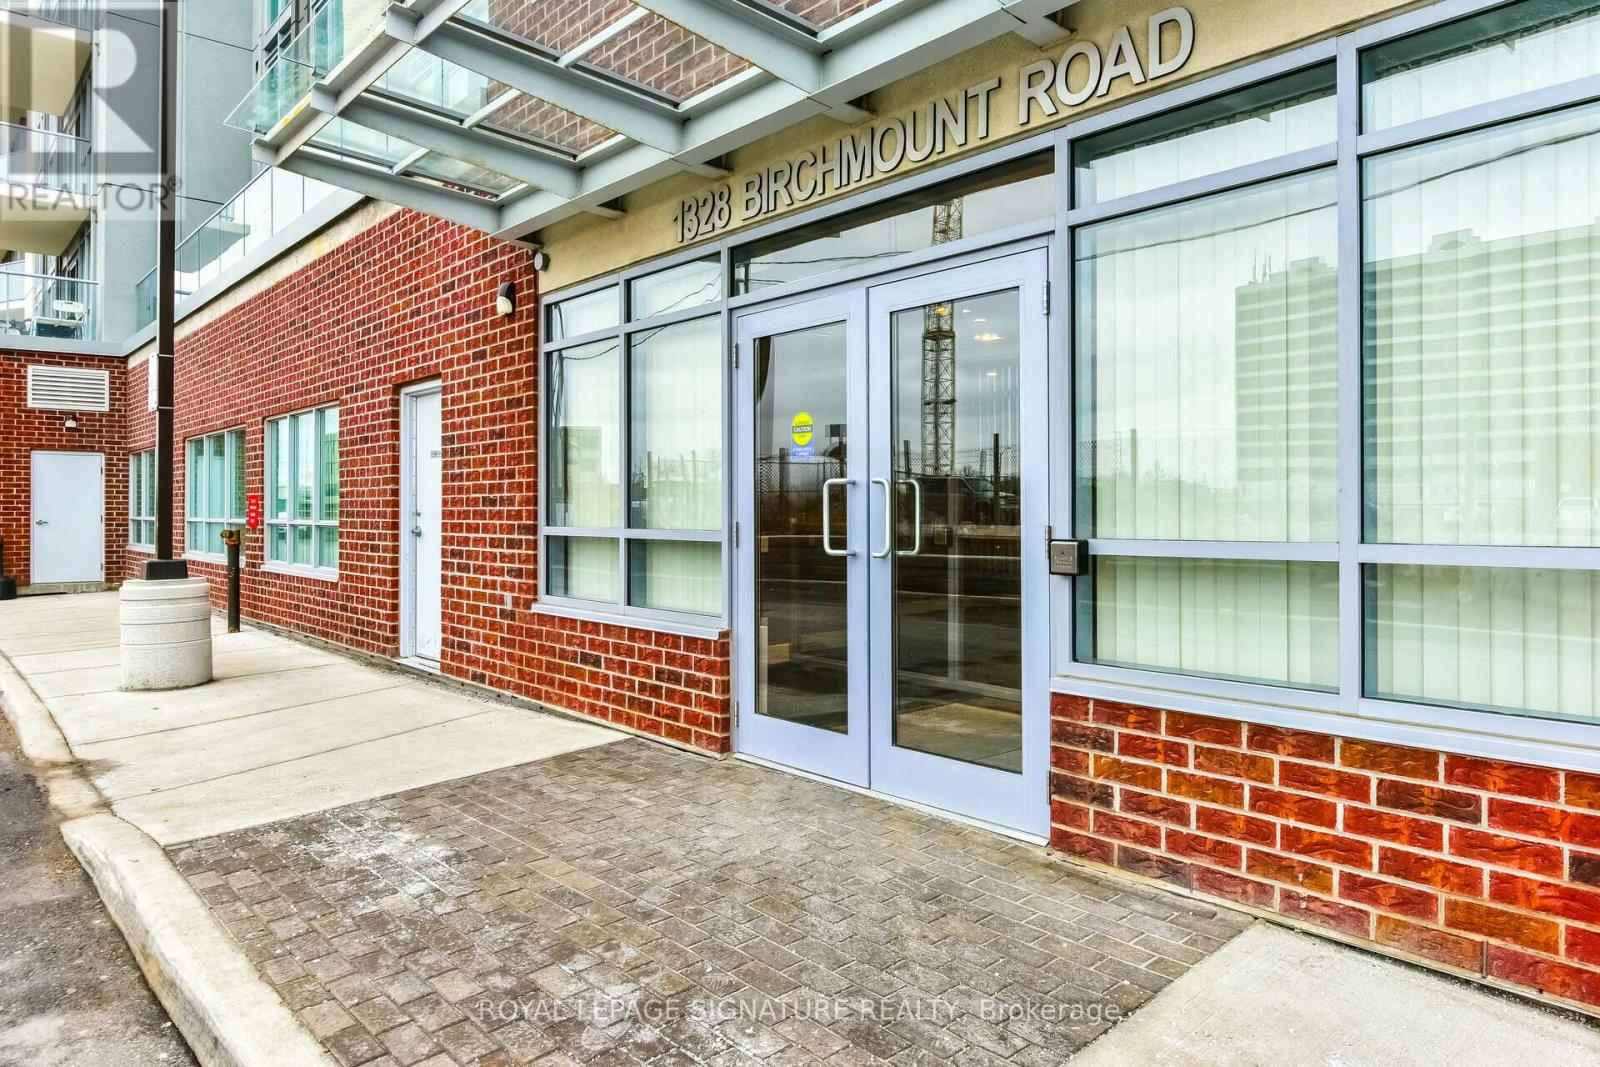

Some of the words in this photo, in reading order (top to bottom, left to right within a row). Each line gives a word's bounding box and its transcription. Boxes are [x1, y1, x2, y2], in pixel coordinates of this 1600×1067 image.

[673, 184, 732, 243] 1328
[741, 78, 1001, 221] BIRCHMOUNT
[1017, 6, 1196, 126] ROAD
